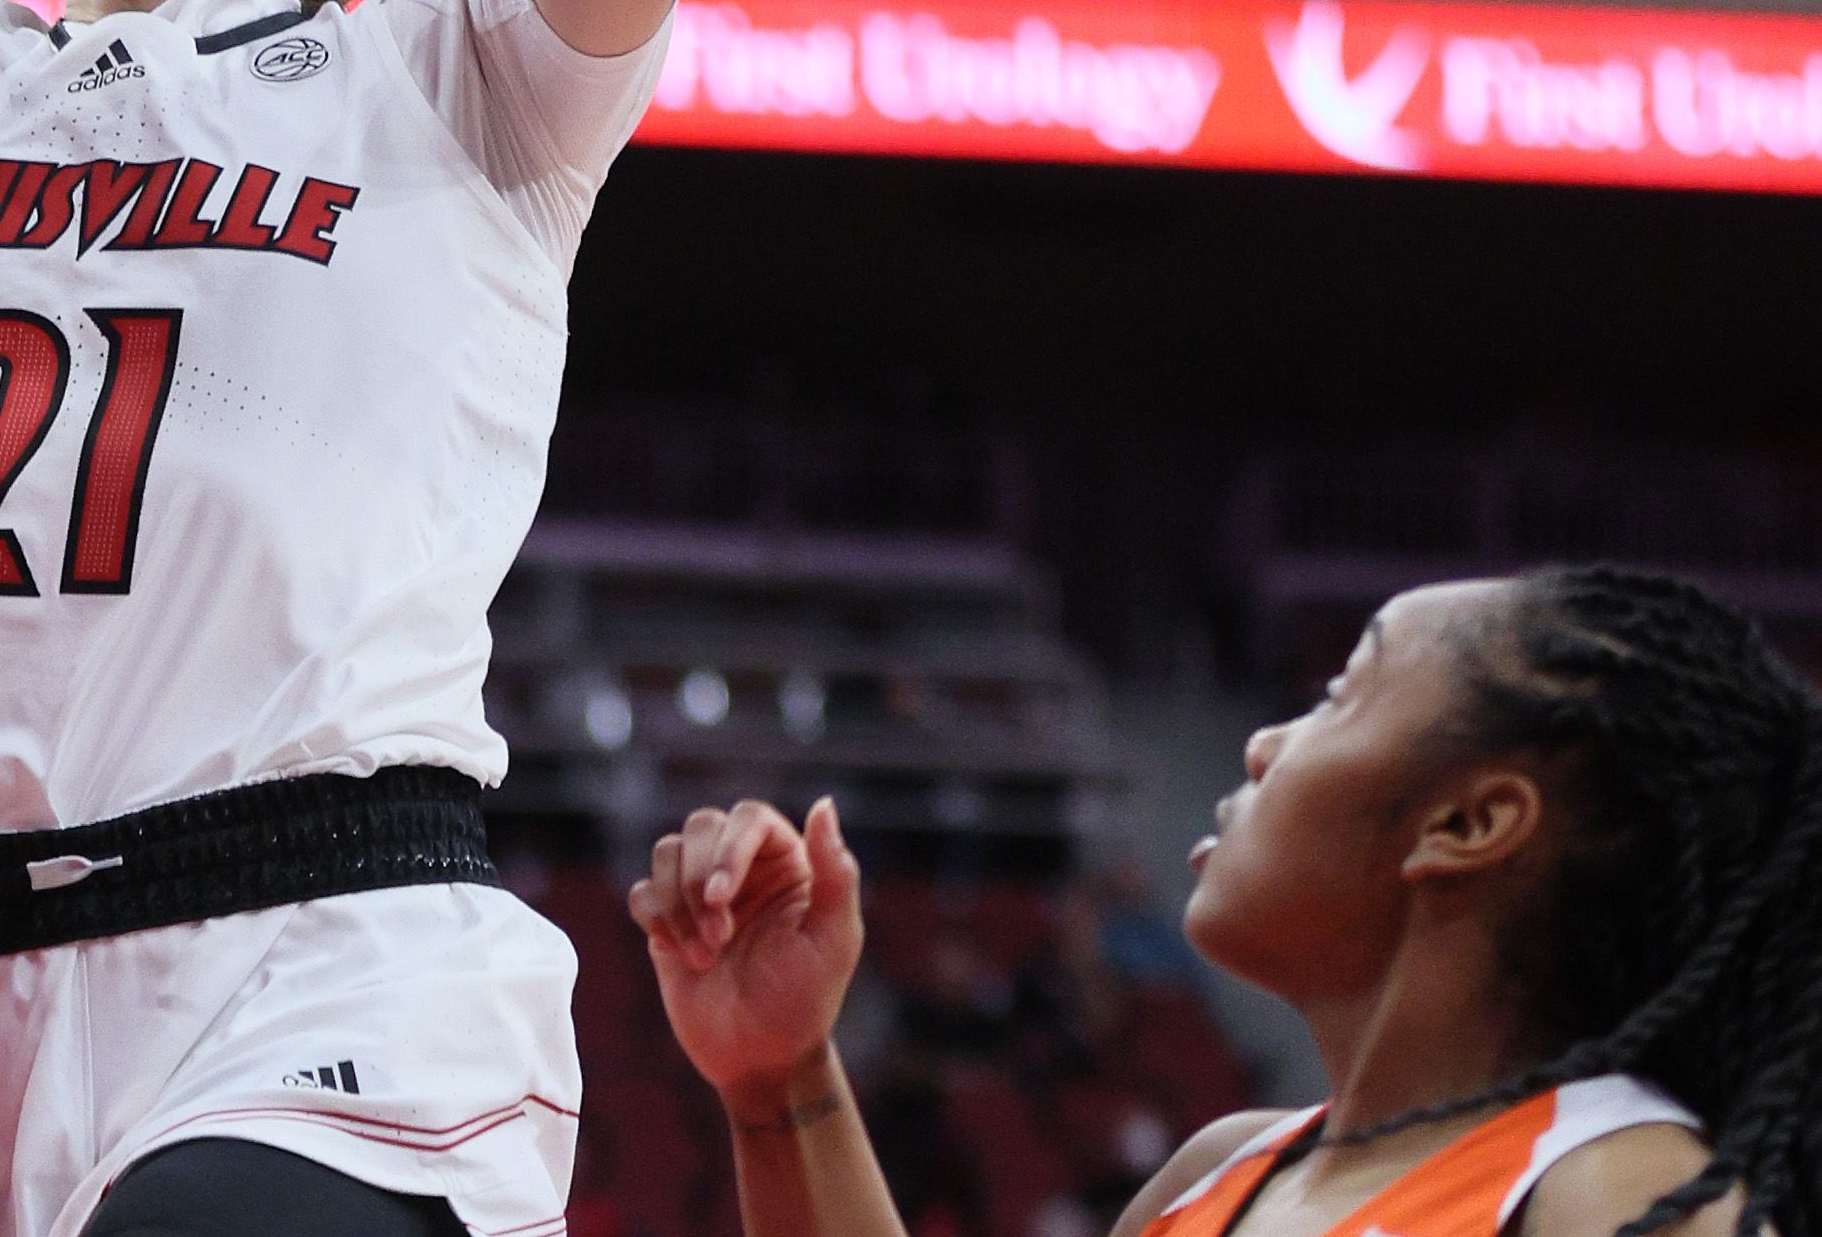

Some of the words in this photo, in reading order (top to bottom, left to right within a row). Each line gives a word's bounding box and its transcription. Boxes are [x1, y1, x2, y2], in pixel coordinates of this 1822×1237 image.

[67, 62, 146, 94] adidas
[861, 11, 1221, 153] Urology
[1442, 36, 1644, 149] First
